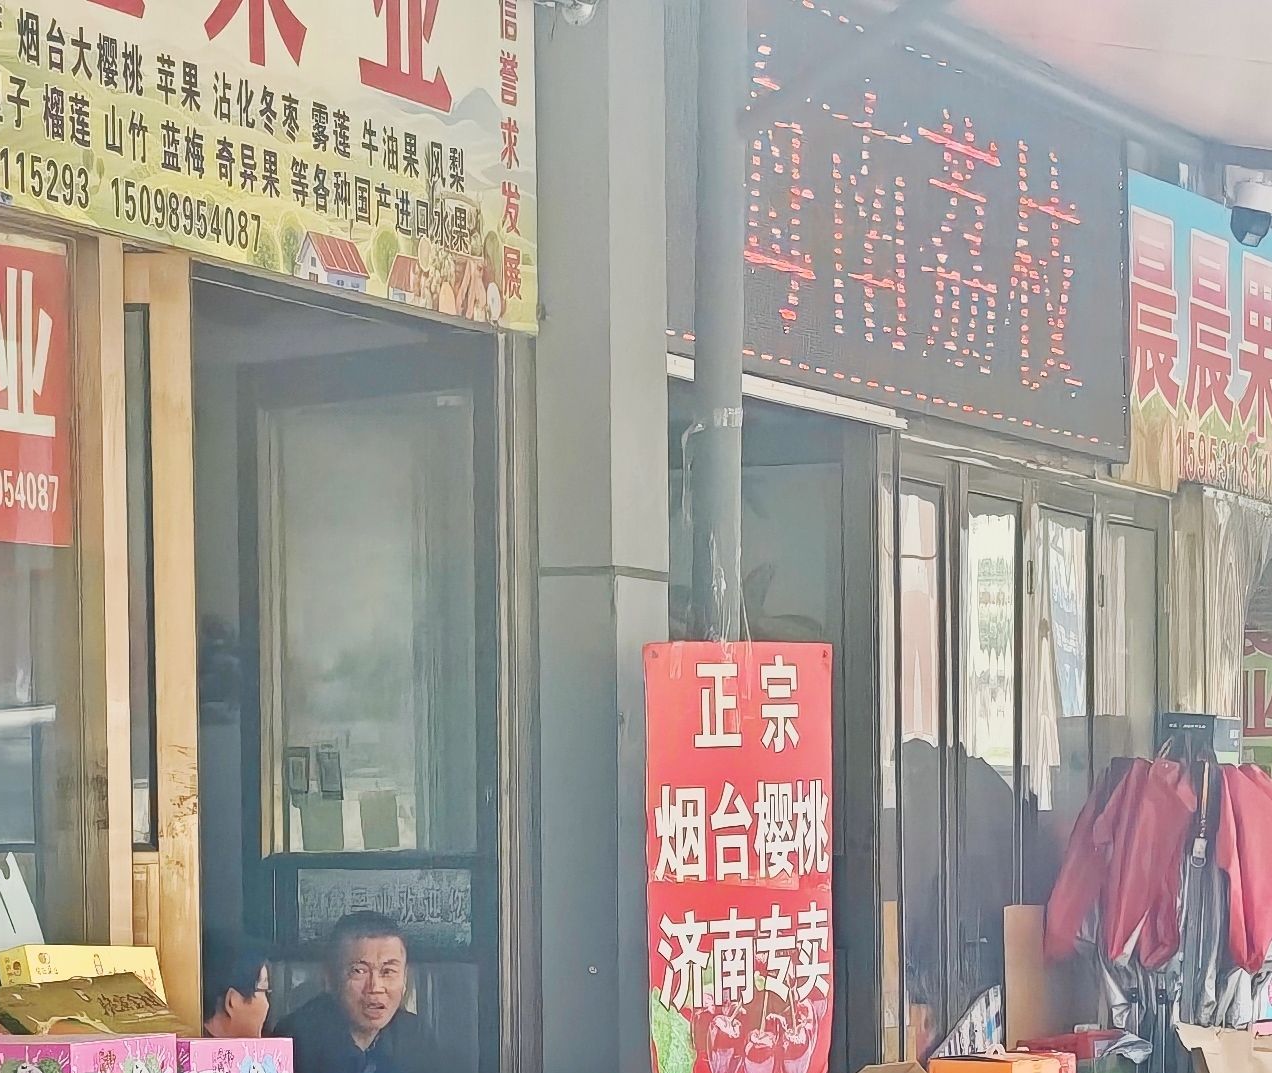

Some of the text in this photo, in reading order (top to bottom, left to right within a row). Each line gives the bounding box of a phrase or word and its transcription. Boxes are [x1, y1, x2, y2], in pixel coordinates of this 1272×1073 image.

[17, 8, 144, 97] 烟台大樱桃
[156, 53, 202, 113] 苹果
[213, 70, 300, 143] 沾化冬枣
[361, 118, 420, 181] 牛油果
[42, 83, 93, 150] 榴莲
[104, 105, 150, 166] 山竹
[160, 120, 206, 181] 蓝梅
[215, 136, 281, 199] 奇异果
[290, 157, 470, 254] 等各种国产进口水果
[498, 0, 522, 302] 信誉求发展
[110, 176, 262, 253] 15098954087
[693, 655, 801, 753] 正宗
[653, 778, 830, 883] 烟台樱桃
[656, 902, 830, 1011] 济南专卖
